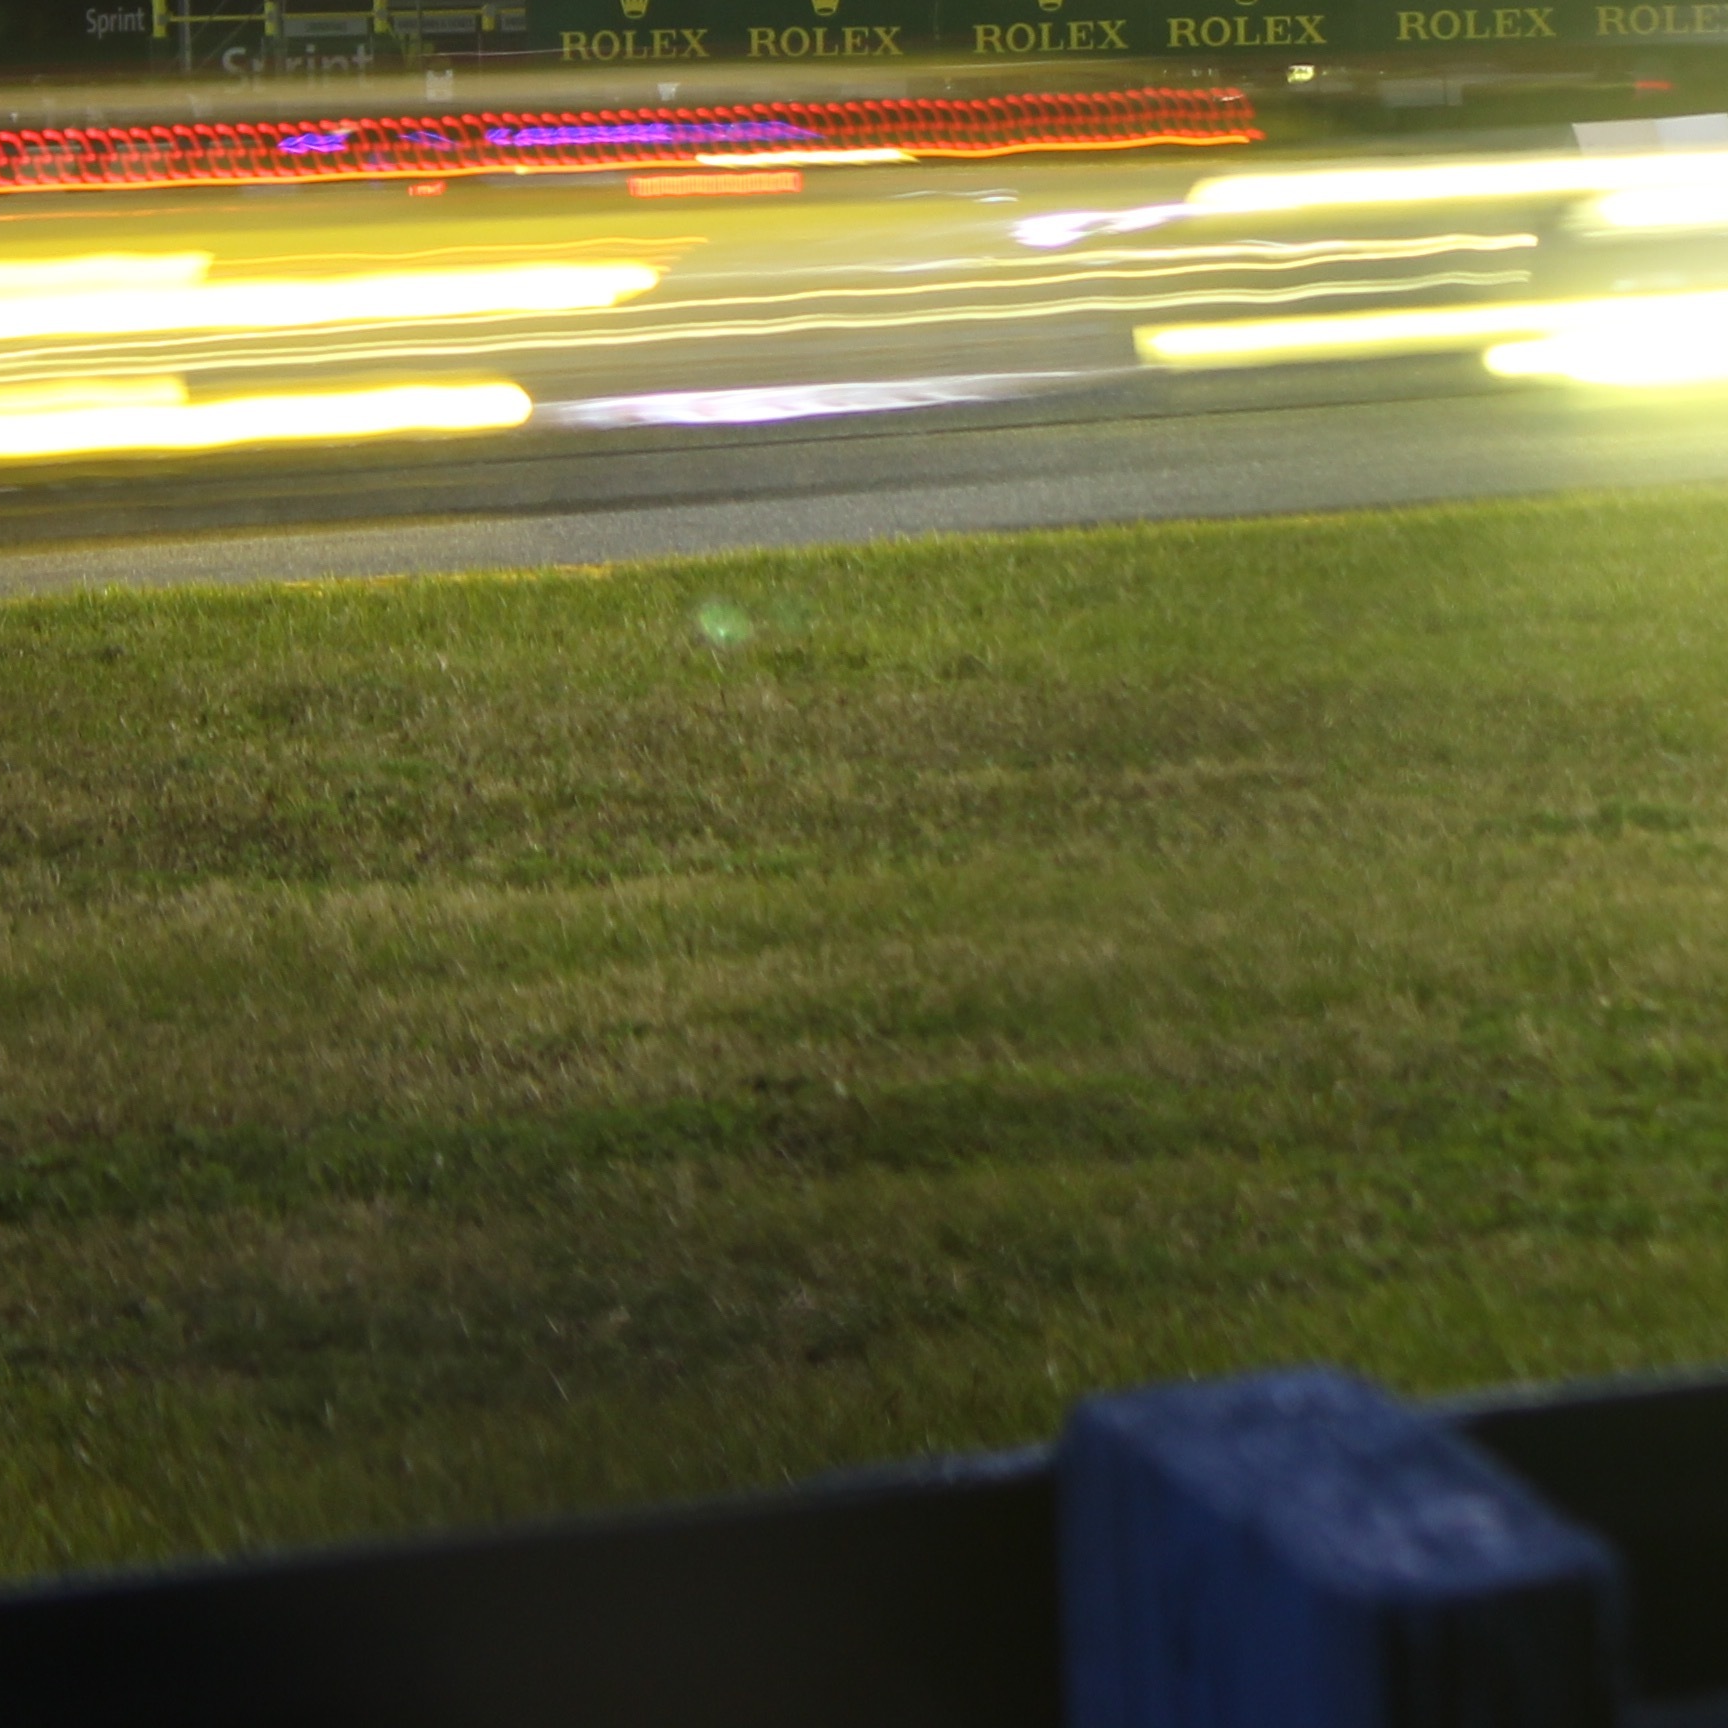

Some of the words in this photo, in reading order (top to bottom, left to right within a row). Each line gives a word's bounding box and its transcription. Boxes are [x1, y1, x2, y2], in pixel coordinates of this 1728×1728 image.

[85, 7, 146, 39] Sprint
[974, 19, 1128, 55] ROLEX
[1166, 14, 1328, 48] ROLEX
[1396, 7, 1557, 42] ROLEX
[561, 28, 709, 62] ROLEX
[747, 25, 903, 59] ROLEX
